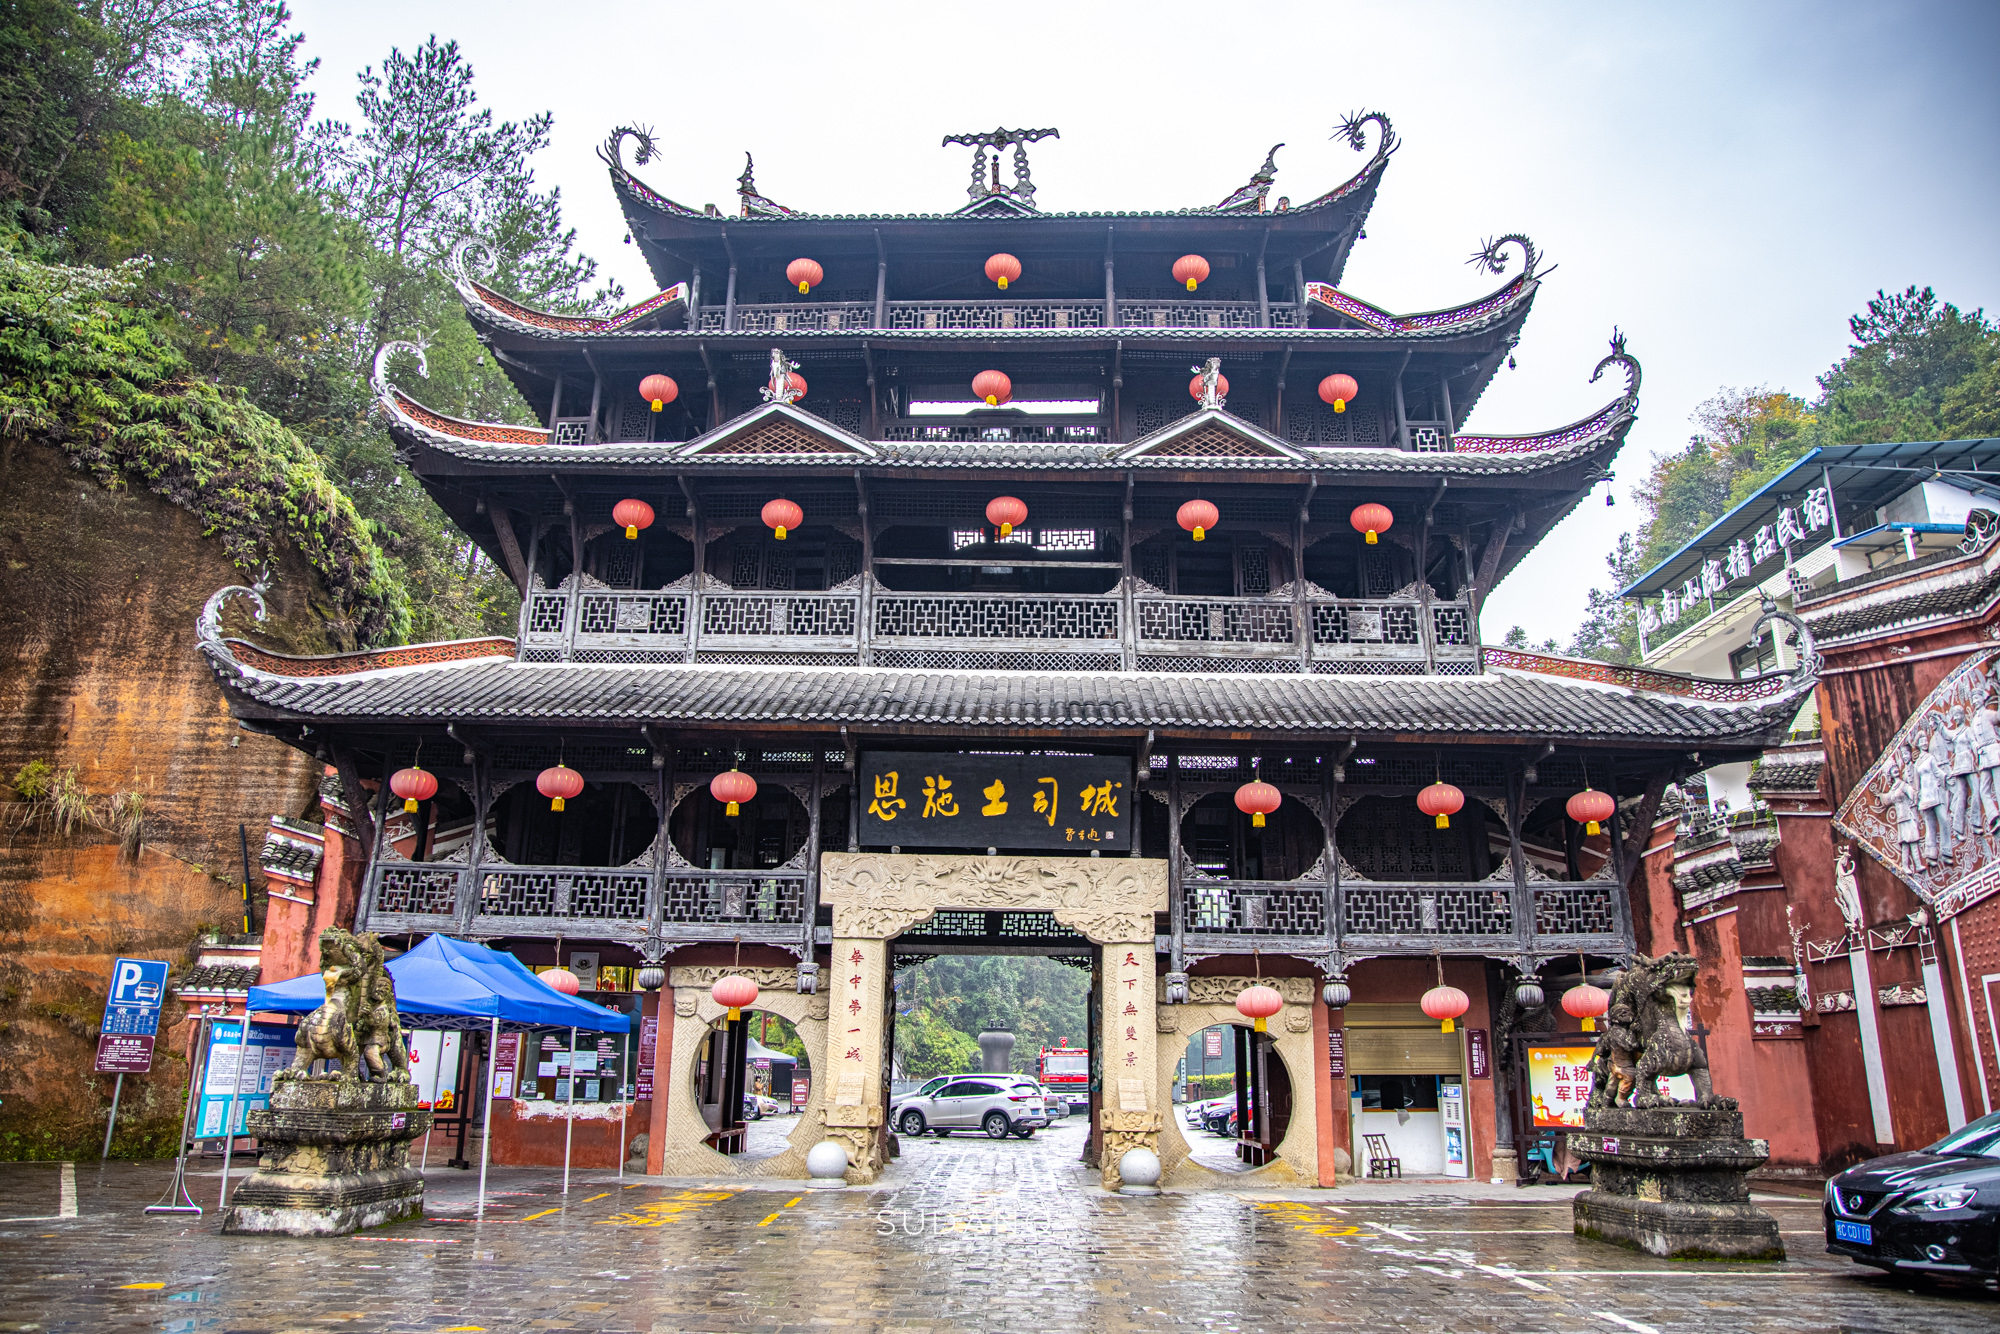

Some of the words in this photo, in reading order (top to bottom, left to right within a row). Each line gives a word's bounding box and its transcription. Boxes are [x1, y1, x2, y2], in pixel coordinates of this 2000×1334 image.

[868, 770, 1122, 827] 恩施土司城
[115, 963, 143, 999] P
[1554, 1066, 1589, 1082] 弘扬
[1555, 1086, 1590, 1102] 军民
